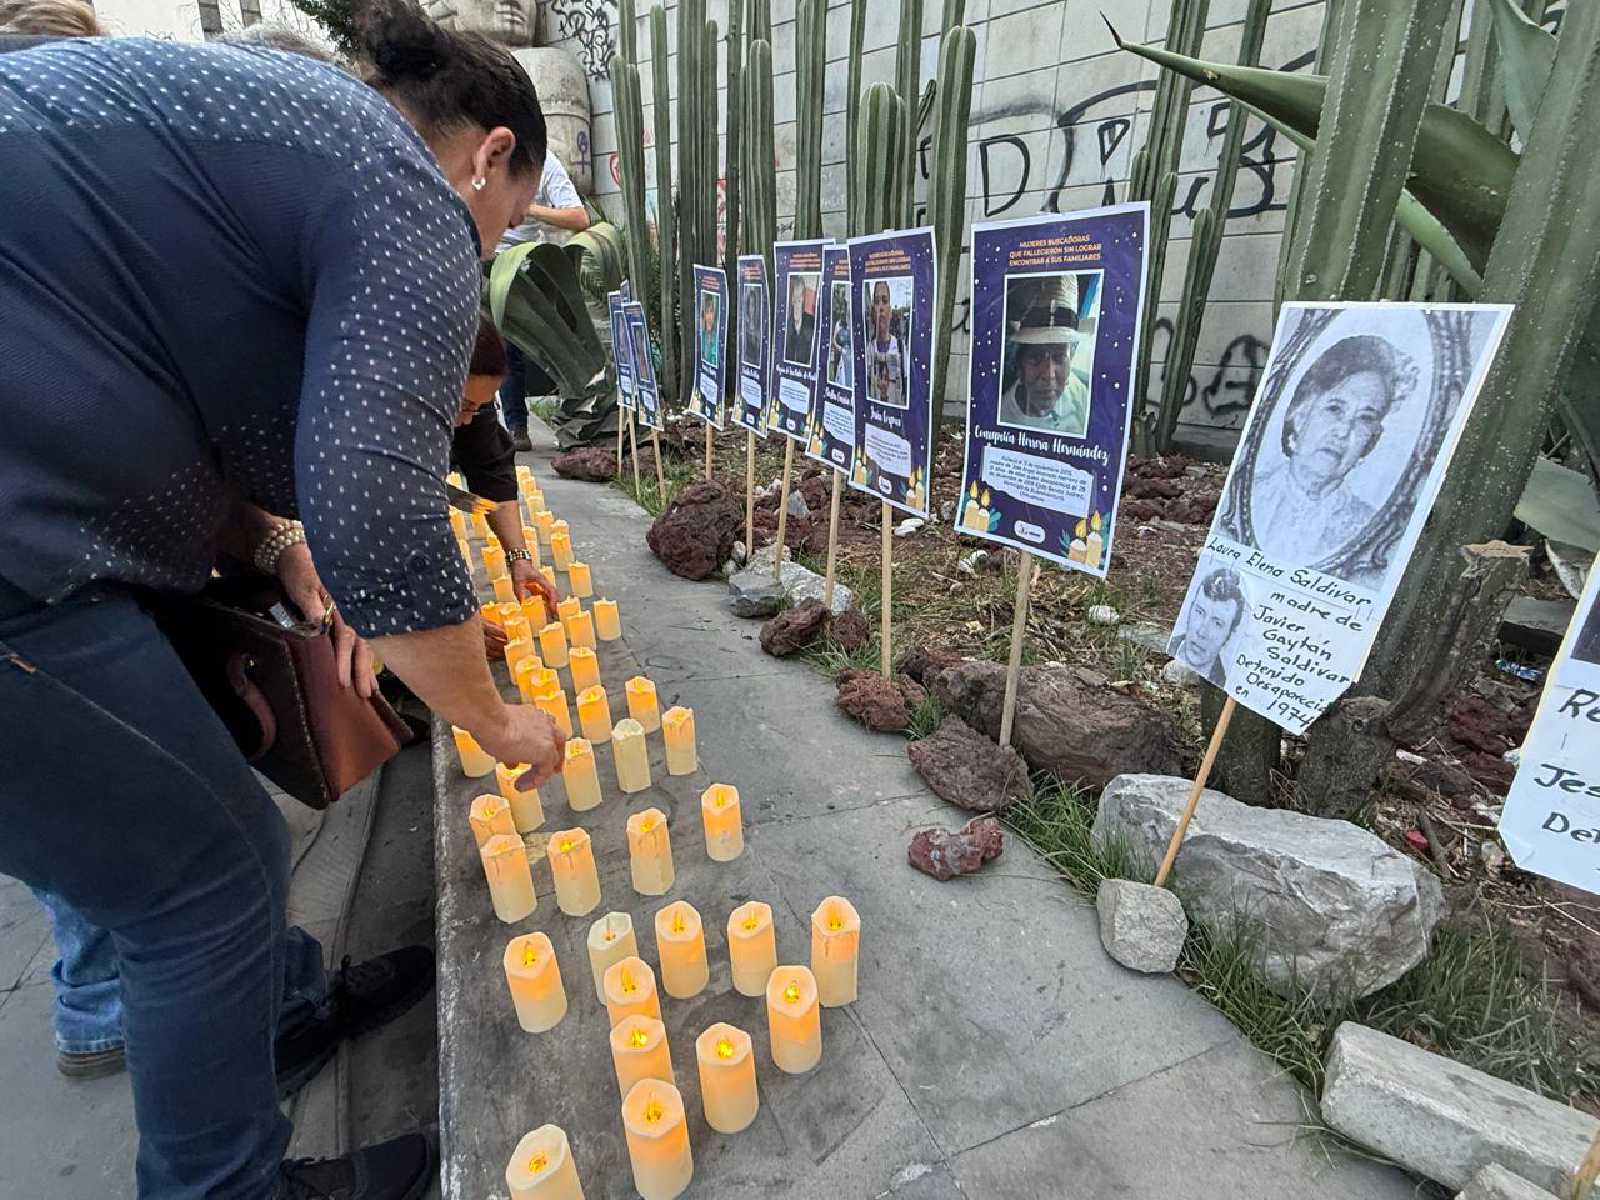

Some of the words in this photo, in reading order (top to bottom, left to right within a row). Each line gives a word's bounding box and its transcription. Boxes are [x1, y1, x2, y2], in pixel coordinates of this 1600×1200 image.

[1009, 251, 1022, 260] QUE
[1206, 536, 1241, 560] Laura
[1253, 604, 1306, 632] Javier
[1269, 591, 1331, 620] madre
[1335, 615, 1363, 632] de
[1236, 654, 1305, 687] Detenido
[1235, 685, 1250, 698] en
[1266, 699, 1316, 729] 1974
